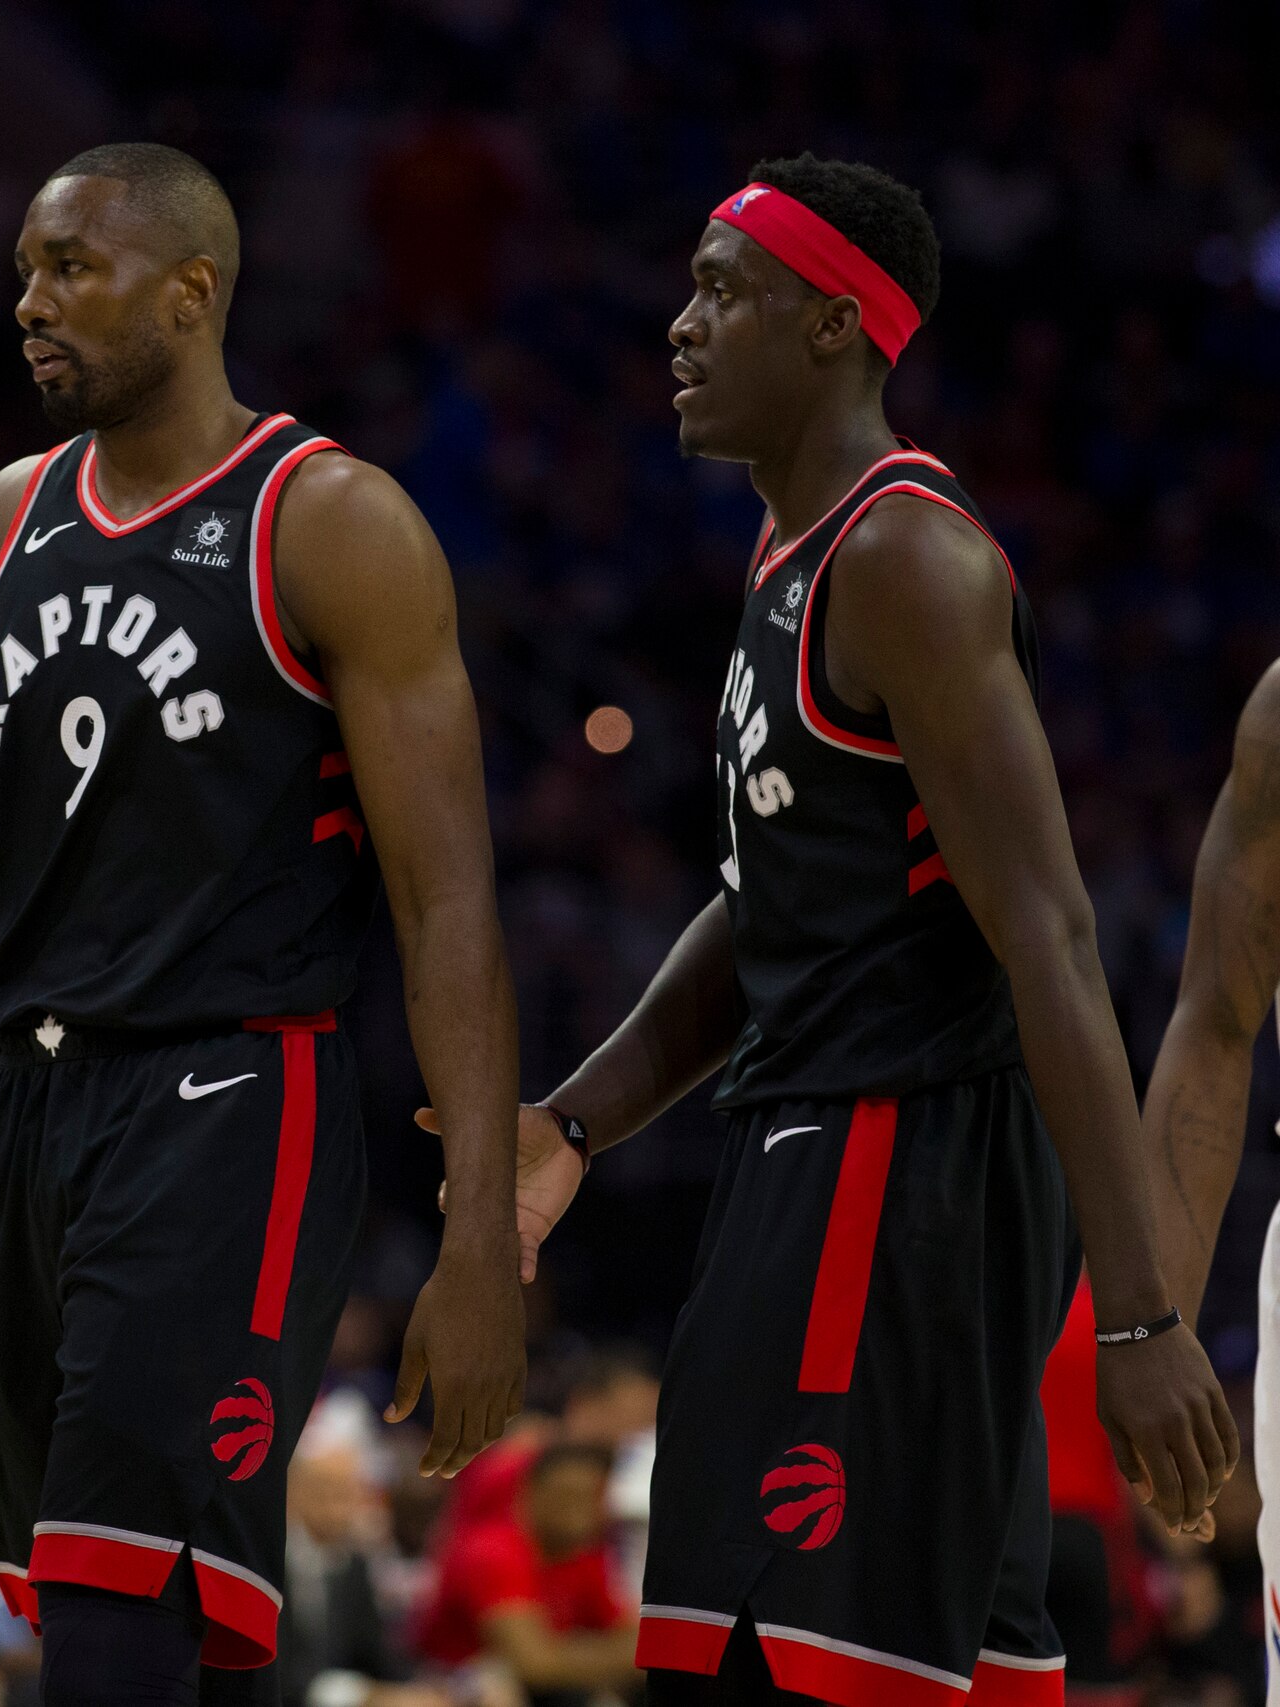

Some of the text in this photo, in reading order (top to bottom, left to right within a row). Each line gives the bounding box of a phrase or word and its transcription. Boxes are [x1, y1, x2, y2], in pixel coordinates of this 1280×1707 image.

[171, 548, 230, 568] Sun Life
[768, 608, 785, 627] Sun
[60, 696, 106, 820] 9
